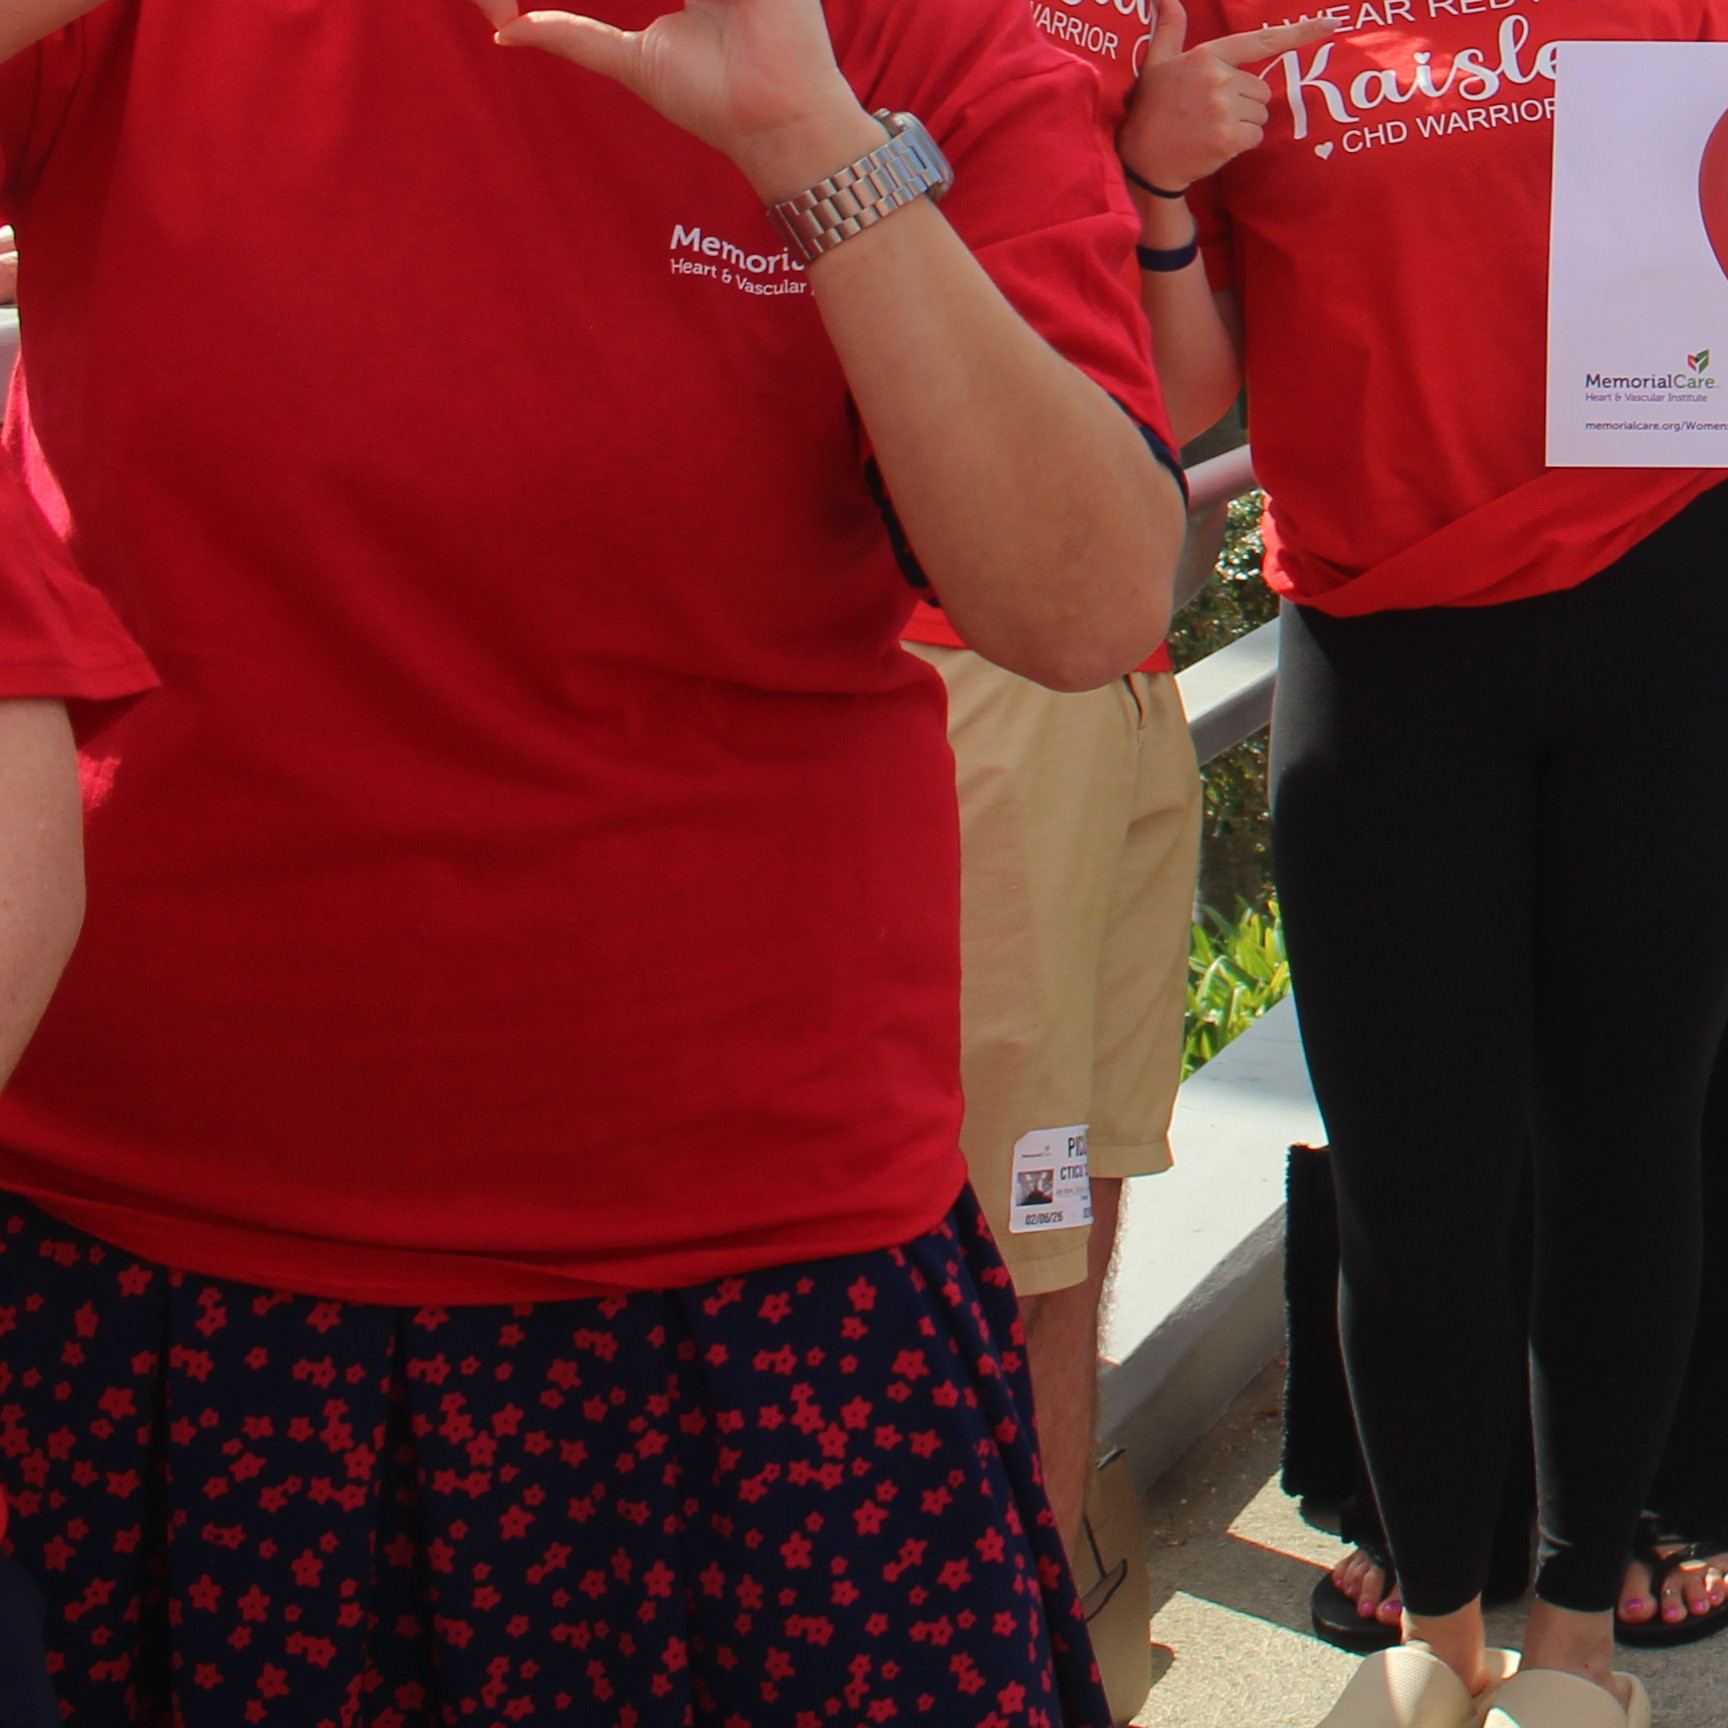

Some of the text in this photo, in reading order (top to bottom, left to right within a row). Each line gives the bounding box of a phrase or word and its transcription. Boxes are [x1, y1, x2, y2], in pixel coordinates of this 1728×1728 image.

[1259, 14, 1558, 140] Kaisle
[1342, 121, 1408, 154] CHD
[670, 258, 807, 296] Heart & Vascular
[1585, 374, 1716, 389] MemorialCare
[1585, 393, 1708, 402] Heart & Vascular Institute
